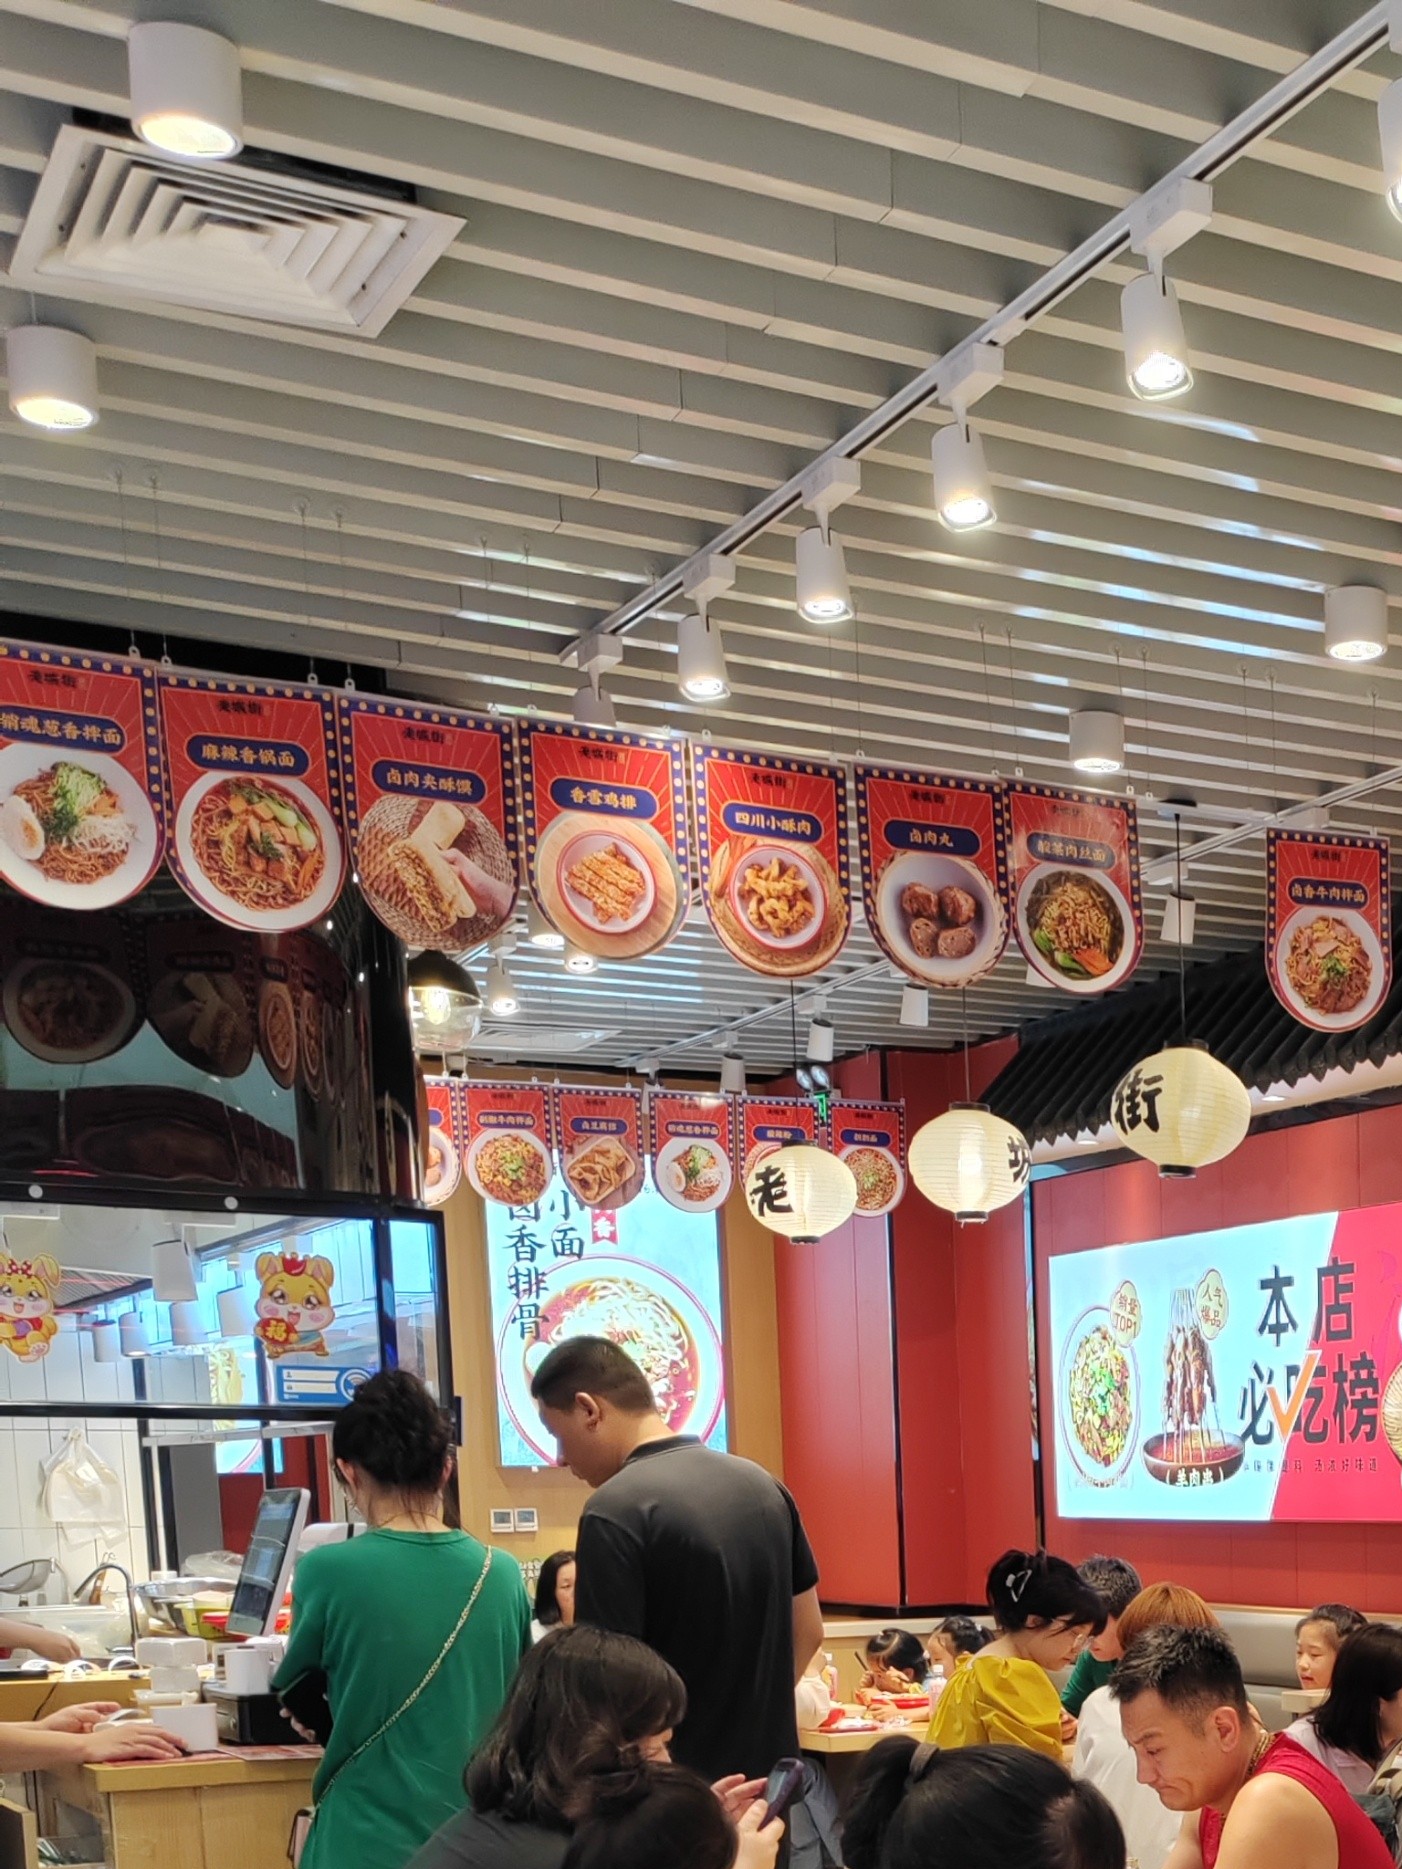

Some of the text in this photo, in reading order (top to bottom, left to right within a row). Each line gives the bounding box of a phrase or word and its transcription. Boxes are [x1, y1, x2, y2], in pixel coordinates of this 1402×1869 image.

[202, 743, 296, 768] 麻辣香锅面
[735, 810, 812, 836] 四川小酥肉
[909, 827, 954, 848] 卤肉丸
[1113, 1068, 1164, 1136] 街
[750, 1165, 794, 1217] 老
[1202, 1284, 1223, 1308] 人气
[1257, 1256, 1355, 1348] 本店
[1114, 1312, 1138, 1338] TOP1
[1239, 1350, 1380, 1446] 必吃榜
